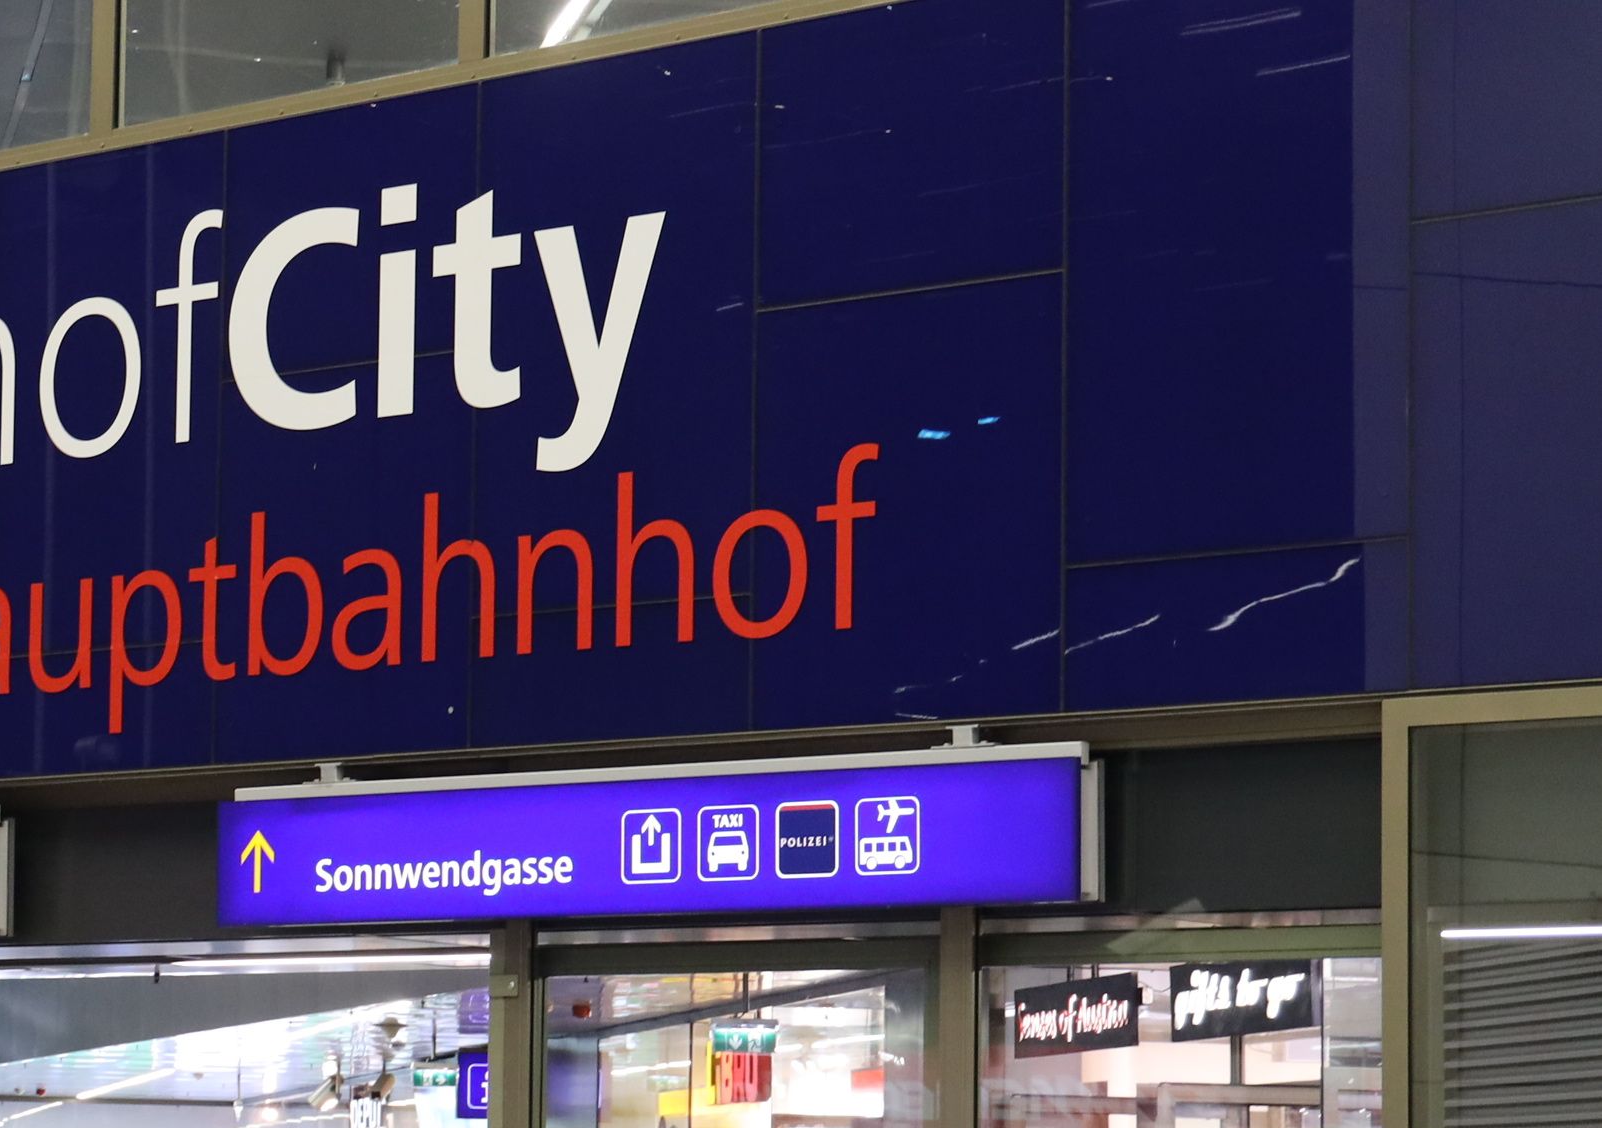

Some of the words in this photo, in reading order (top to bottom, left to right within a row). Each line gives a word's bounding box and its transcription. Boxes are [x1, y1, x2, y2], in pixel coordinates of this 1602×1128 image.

[711, 813, 744, 828] TAXI
[780, 835, 828, 848] POLIZEI
[314, 852, 574, 896] Sonnwendgasse
